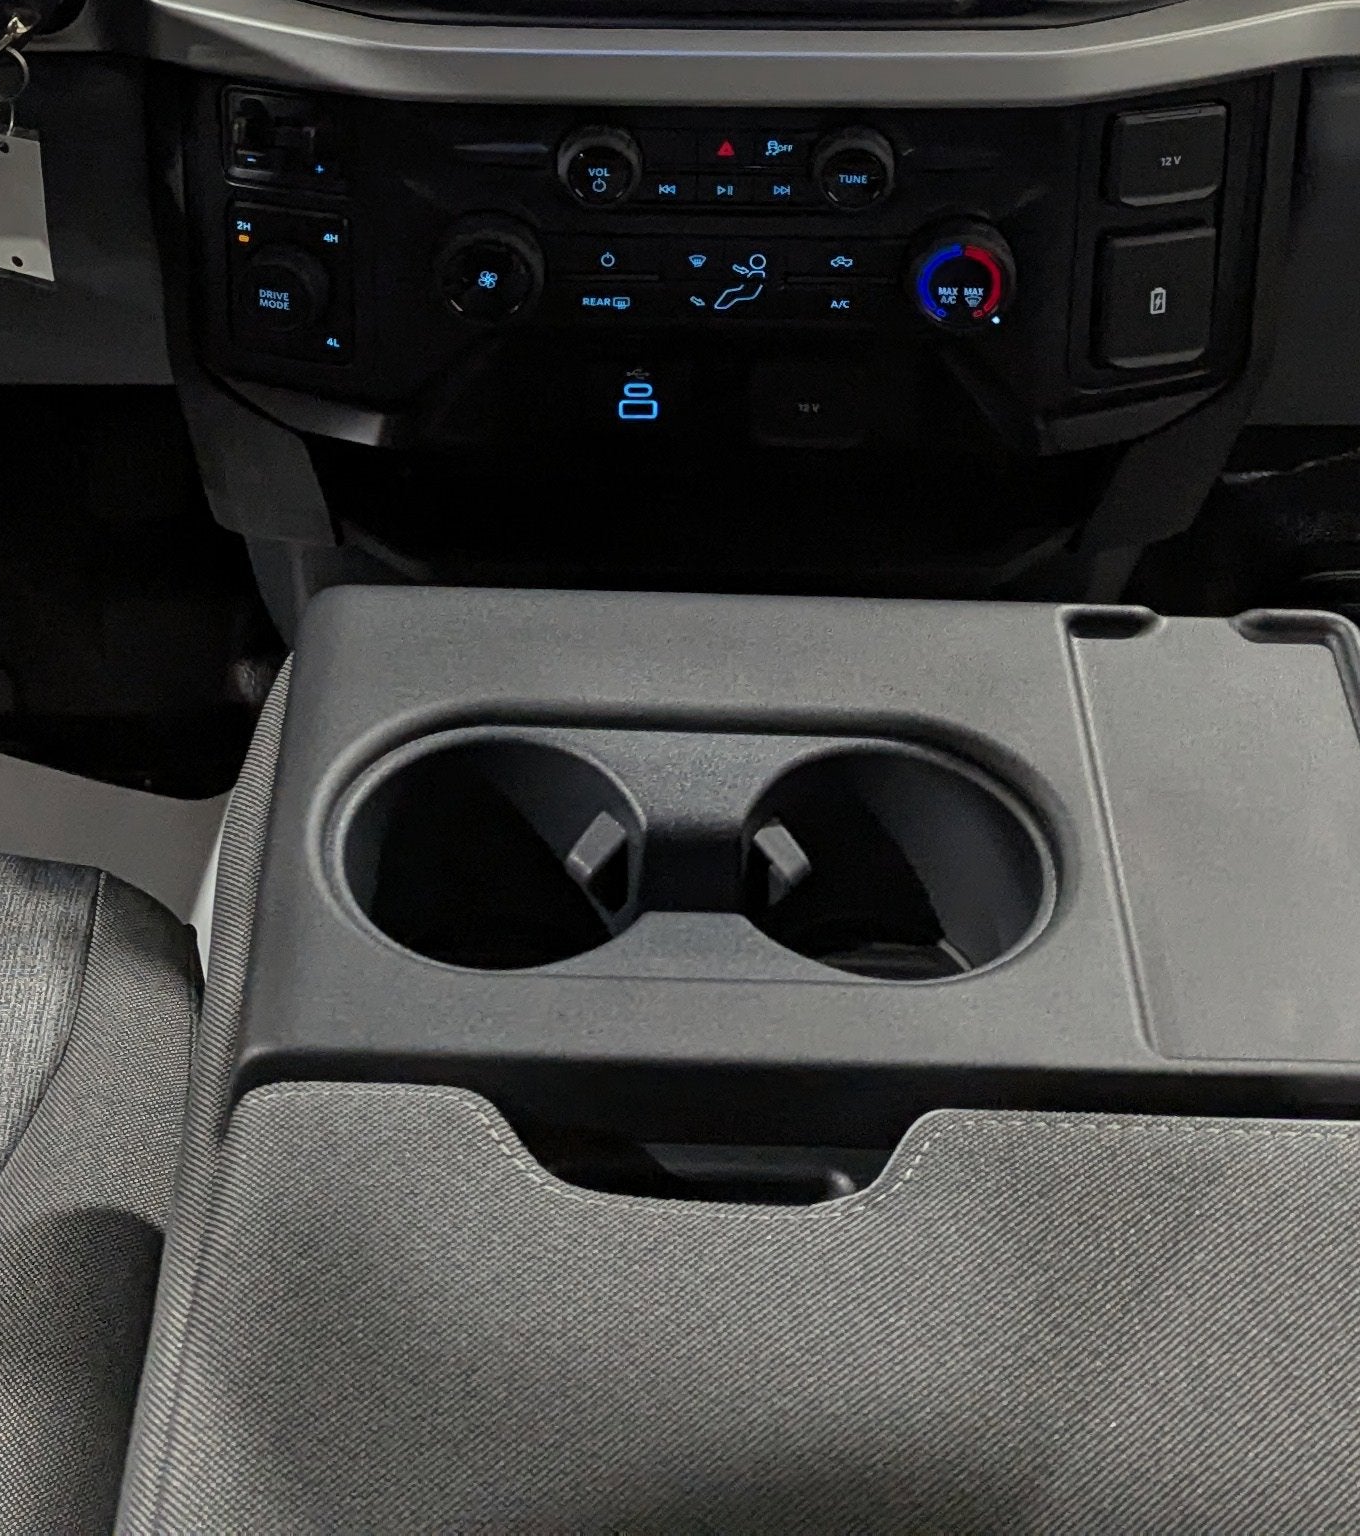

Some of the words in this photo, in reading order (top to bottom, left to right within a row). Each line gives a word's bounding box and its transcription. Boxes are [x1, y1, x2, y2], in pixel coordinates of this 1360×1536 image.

[1161, 157, 1172, 166] 12
[1174, 156, 1182, 165] V
[588, 168, 610, 177] VOL
[839, 174, 868, 184] TUNE
[237, 221, 251, 232] 2H
[323, 232, 339, 244] 4H
[259, 289, 290, 301] DRIVE
[938, 286, 958, 295] MAX
[963, 287, 984, 296] MAX
[259, 298, 290, 311] MODE
[582, 297, 611, 307] REAR
[830, 300, 850, 309] A/C
[326, 337, 340, 348] 4L
